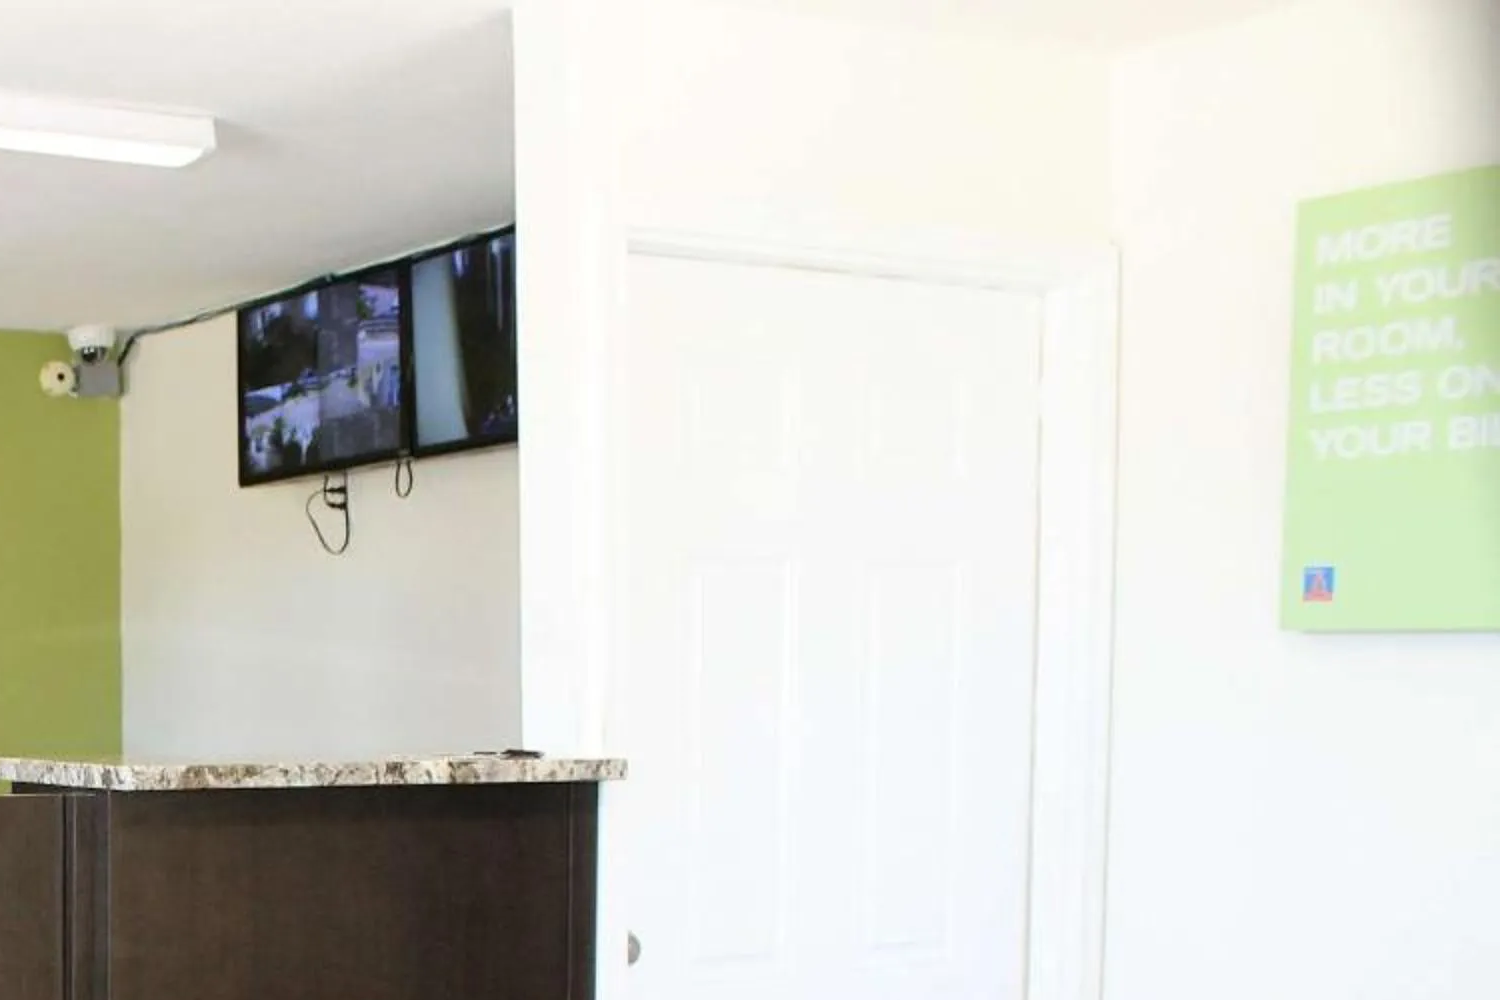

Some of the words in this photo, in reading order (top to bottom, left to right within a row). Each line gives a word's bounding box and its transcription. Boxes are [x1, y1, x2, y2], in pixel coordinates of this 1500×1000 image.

[1317, 215, 1451, 265] MORE
[1314, 283, 1358, 314] IN
[1378, 258, 1500, 306] YOUR
[1313, 317, 1465, 363] ROOM.
[1311, 371, 1421, 412] LESS
[1311, 420, 1431, 460] YOUR
